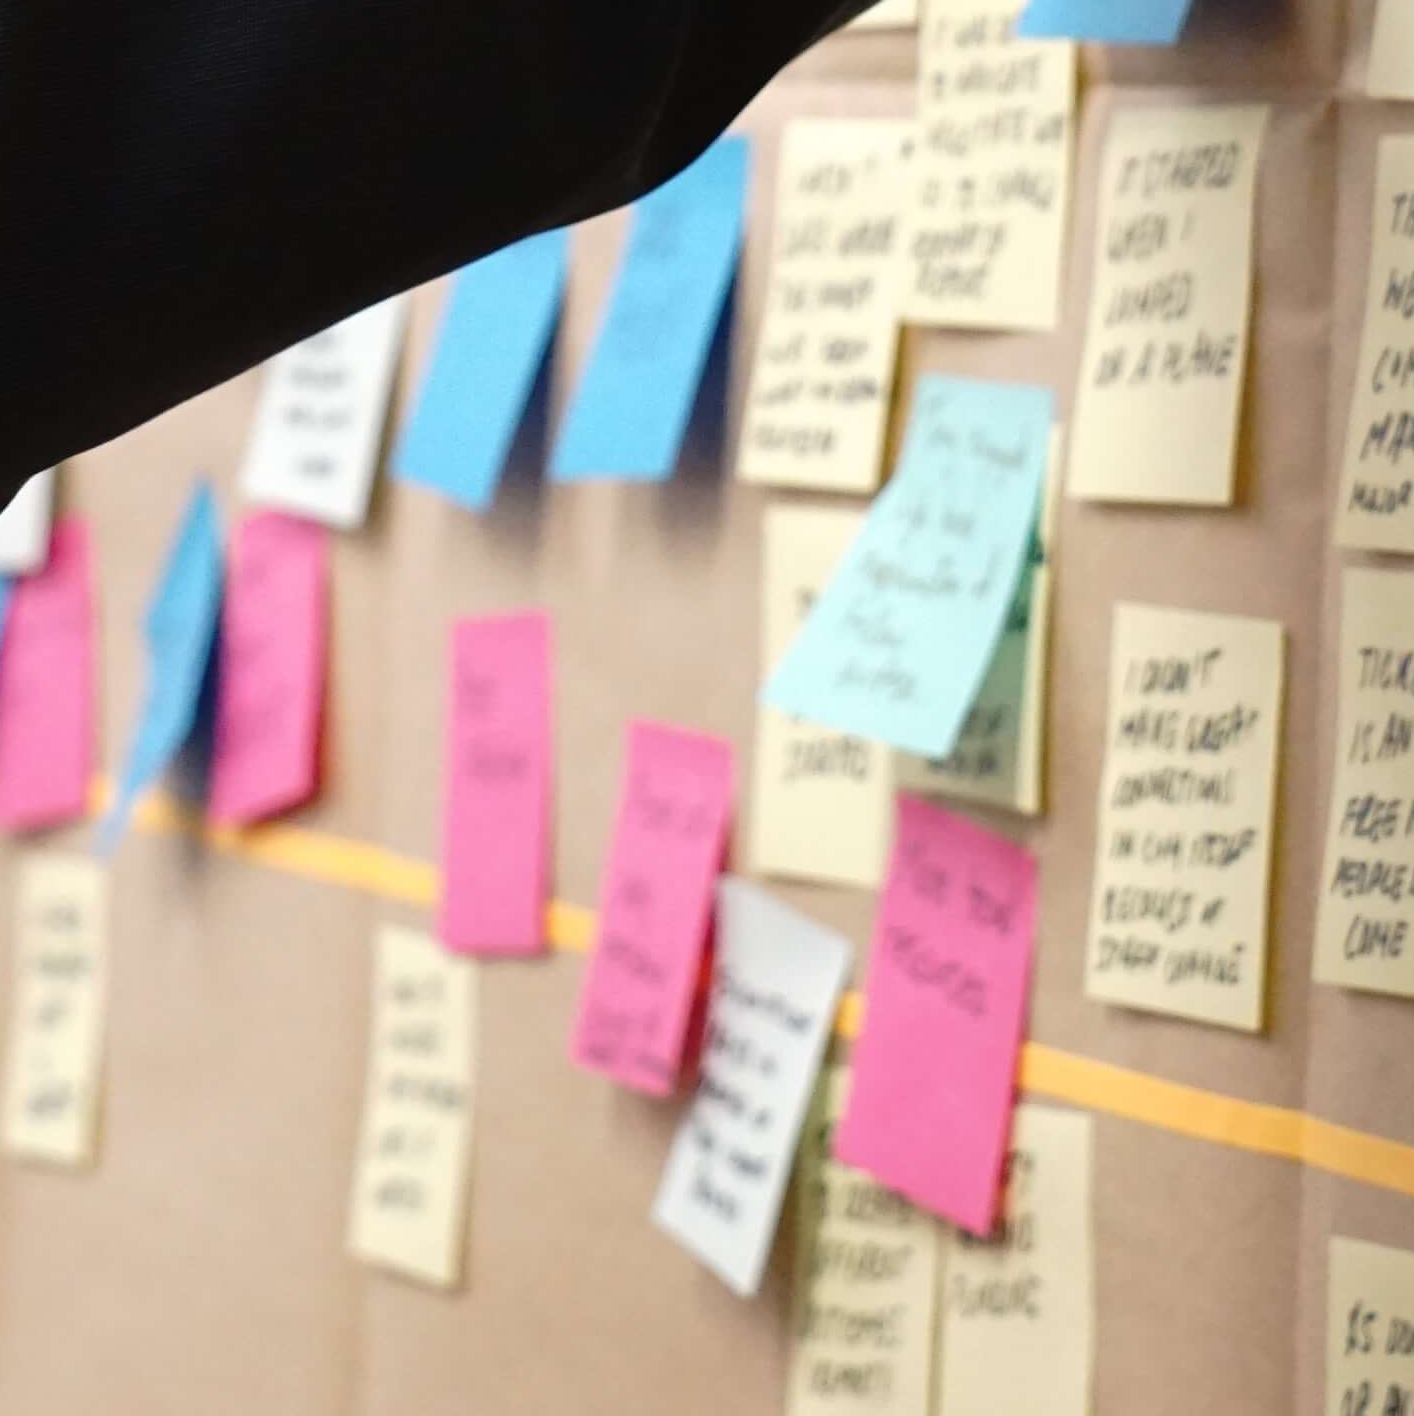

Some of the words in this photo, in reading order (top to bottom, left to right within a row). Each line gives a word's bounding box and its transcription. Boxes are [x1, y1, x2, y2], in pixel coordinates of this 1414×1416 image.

[1348, 720, 1374, 764] IS
[1377, 712, 1413, 761] AN
[1339, 792, 1403, 845] FREE
[1343, 915, 1410, 961] COME
